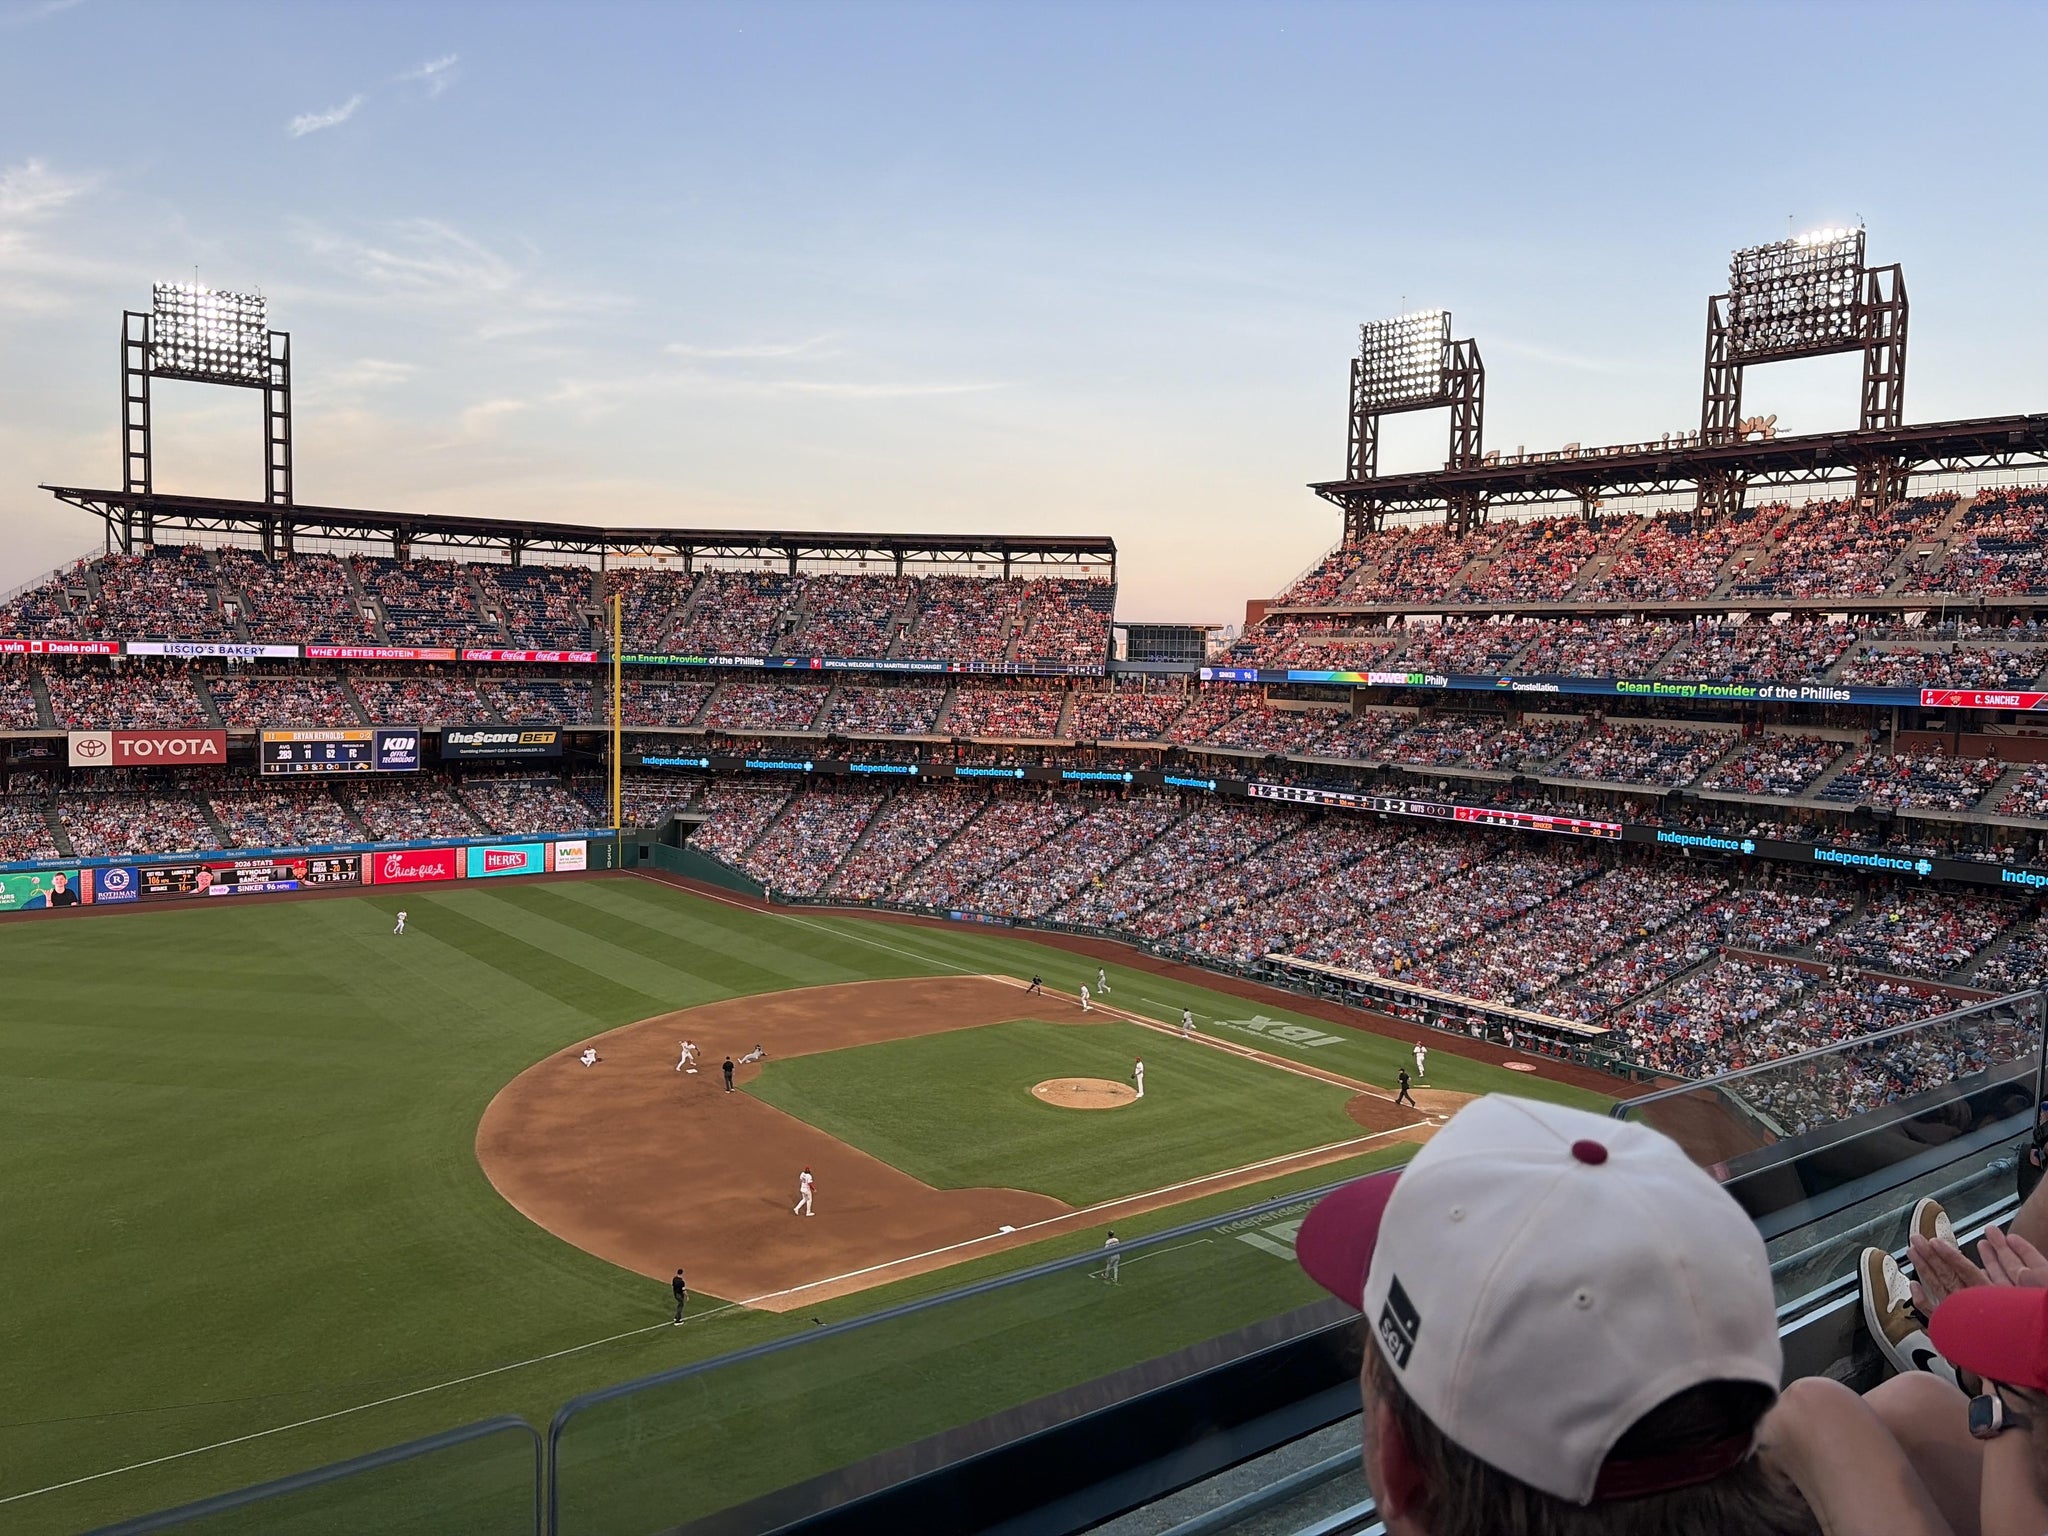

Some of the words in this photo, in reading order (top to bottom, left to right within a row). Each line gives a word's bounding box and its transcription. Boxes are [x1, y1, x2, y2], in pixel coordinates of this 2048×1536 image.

[4, 642, 24, 651] win
[49, 643, 79, 652] Deals
[81, 644, 98, 652] roll
[100, 643, 110, 652] in
[164, 645, 214, 654] LISCIO'S
[219, 646, 266, 655] BAKERY
[310, 648, 338, 656] WHEY
[342, 649, 374, 657] BETTER
[612, 654, 636, 662] Cean
[638, 654, 668, 664] Energy
[670, 655, 708, 664] Provider
[709, 656, 718, 664] of
[719, 656, 732, 664] the
[734, 656, 764, 666] Phillies
[1425, 675, 1448, 688] Philly
[1512, 682, 1560, 692] Constellation
[1616, 682, 1650, 693] Clean
[1654, 682, 1696, 698] Energy
[1699, 684, 1756, 697] Provider
[1758, 686, 1773, 698] of
[1775, 686, 1798, 698] the
[1800, 686, 1850, 700] Phillies
[1975, 694, 1982, 704] C.
[1984, 695, 2020, 706] SANCHEZ
[293, 732, 314, 740] BRYAN
[314, 732, 344, 740] REYNOLDS
[448, 732, 518, 744] theScore
[522, 734, 553, 742] BET
[118, 738, 218, 756] TOYOTA
[382, 738, 416, 750] KDI
[276, 750, 292, 760] .283
[304, 750, 311, 759] 11
[642, 756, 698, 766] Independence
[746, 760, 802, 770] Independence
[850, 763, 907, 774] Independence
[956, 767, 1013, 777] Independence
[1062, 771, 1122, 782] Independence
[1164, 776, 1208, 788] Independence
[1410, 804, 1425, 813] OUTS
[1657, 830, 1738, 850] Independence
[560, 848, 583, 856] WM
[488, 854, 522, 866] HERR'S
[1814, 848, 1912, 871] Independence
[384, 857, 445, 878] Chick-fil-A
[2002, 868, 2048, 888] Indep
